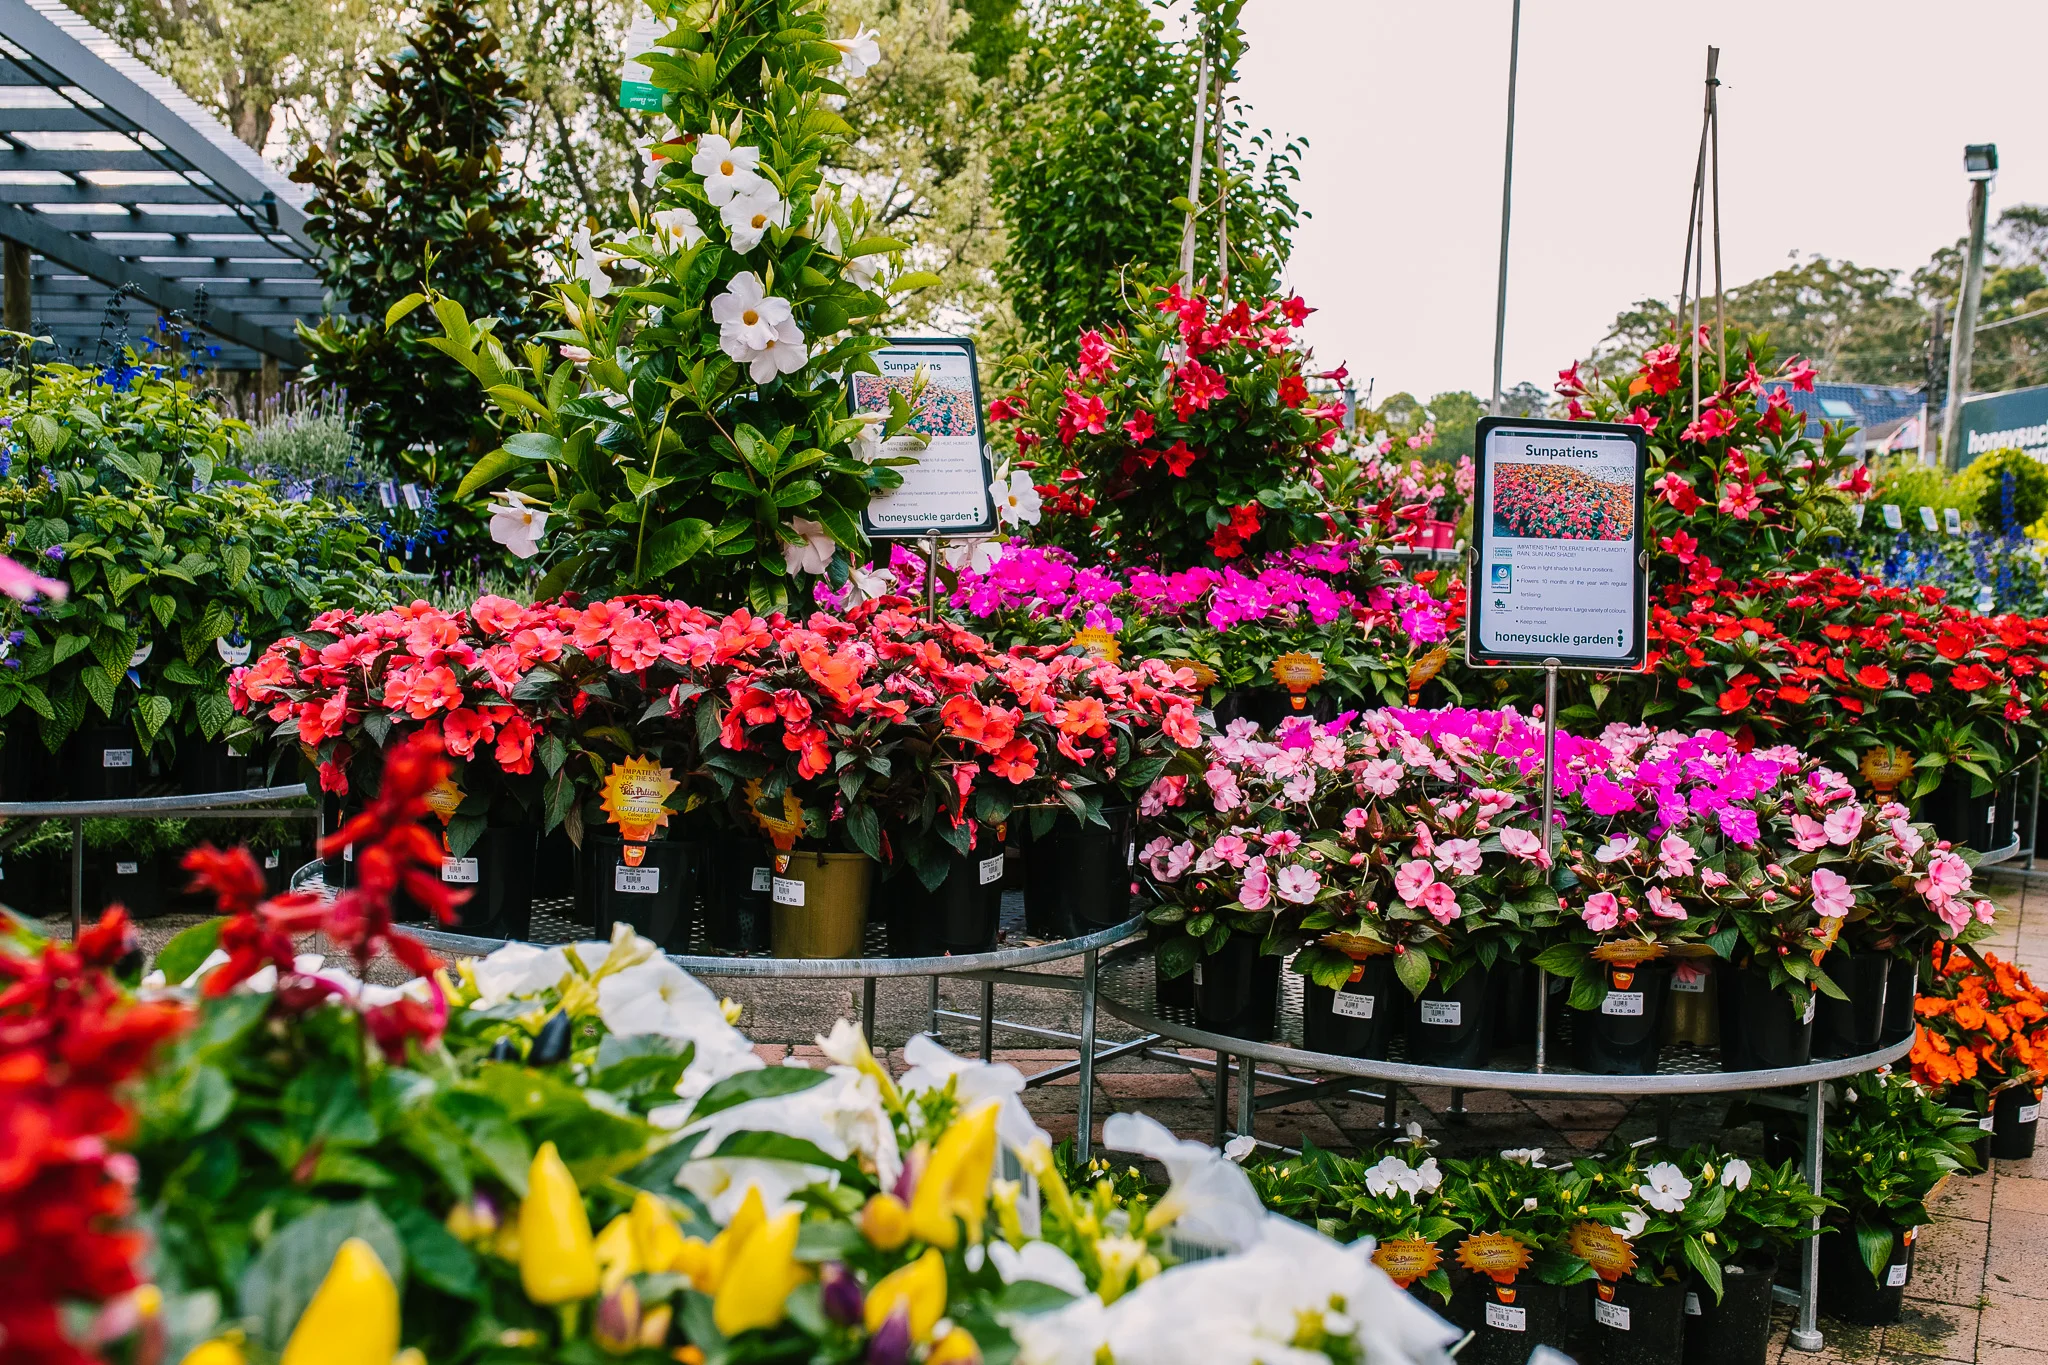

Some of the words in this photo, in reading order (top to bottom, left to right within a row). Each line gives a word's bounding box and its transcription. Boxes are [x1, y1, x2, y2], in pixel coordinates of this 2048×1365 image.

[1526, 444, 1598, 460] Sunpatiens
[878, 513, 937, 523] honeysuckle
[940, 512, 972, 522] garden
[1495, 632, 1570, 644] honeysuckle
[1573, 634, 1614, 646] garden
